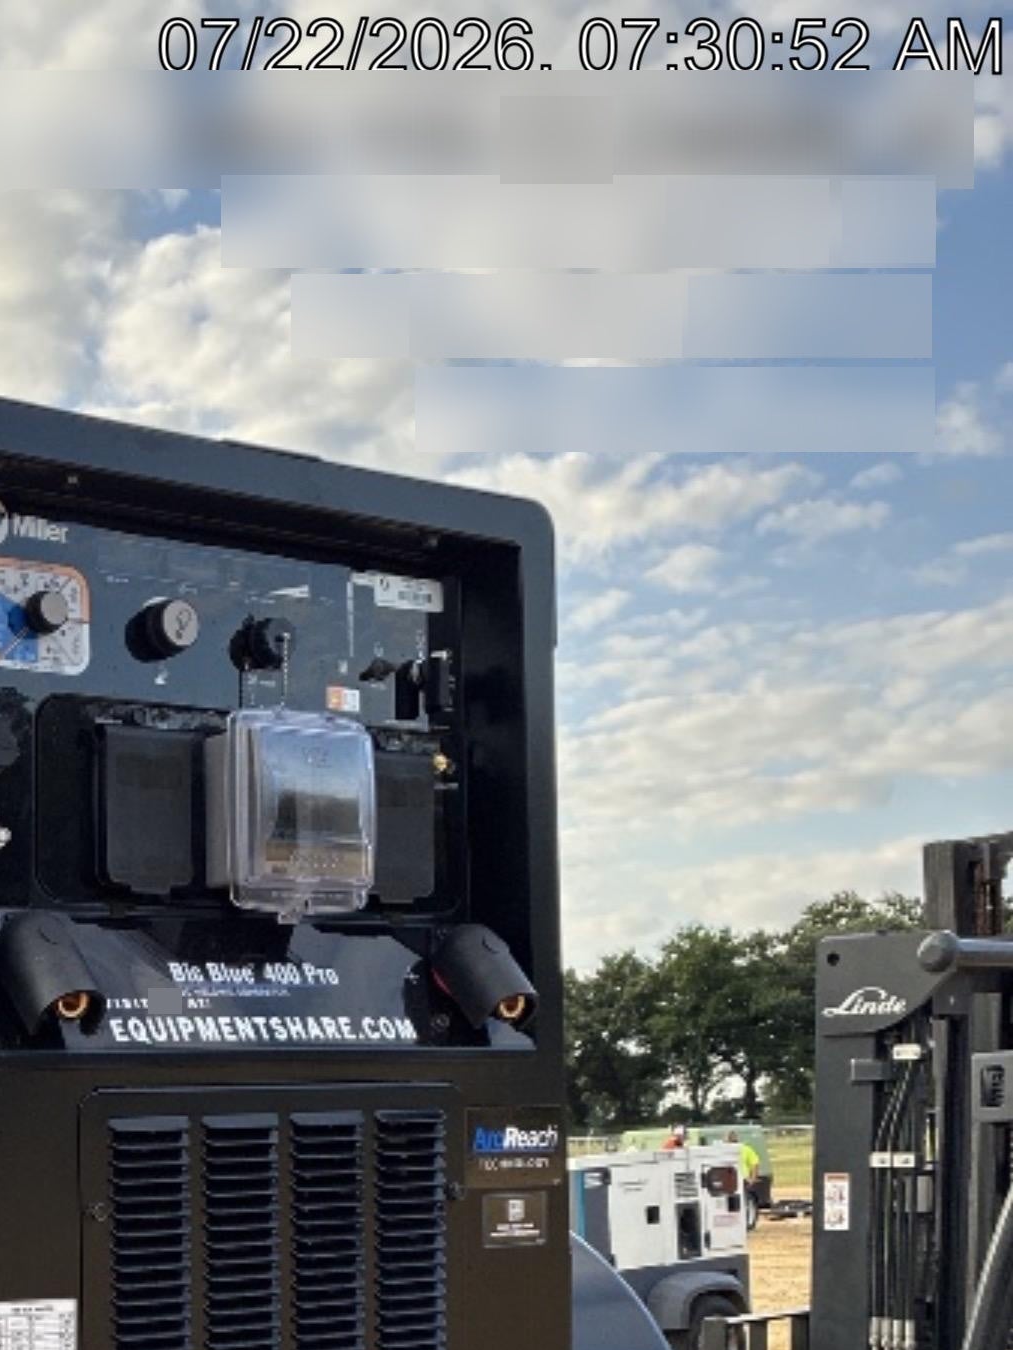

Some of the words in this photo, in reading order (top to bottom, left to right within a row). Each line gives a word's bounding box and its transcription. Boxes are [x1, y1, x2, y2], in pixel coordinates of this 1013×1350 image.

[10, 512, 69, 543] Miller
[821, 986, 907, 1017] Linde
[109, 1016, 418, 1043] EQUIPMENTSHARE.COM
